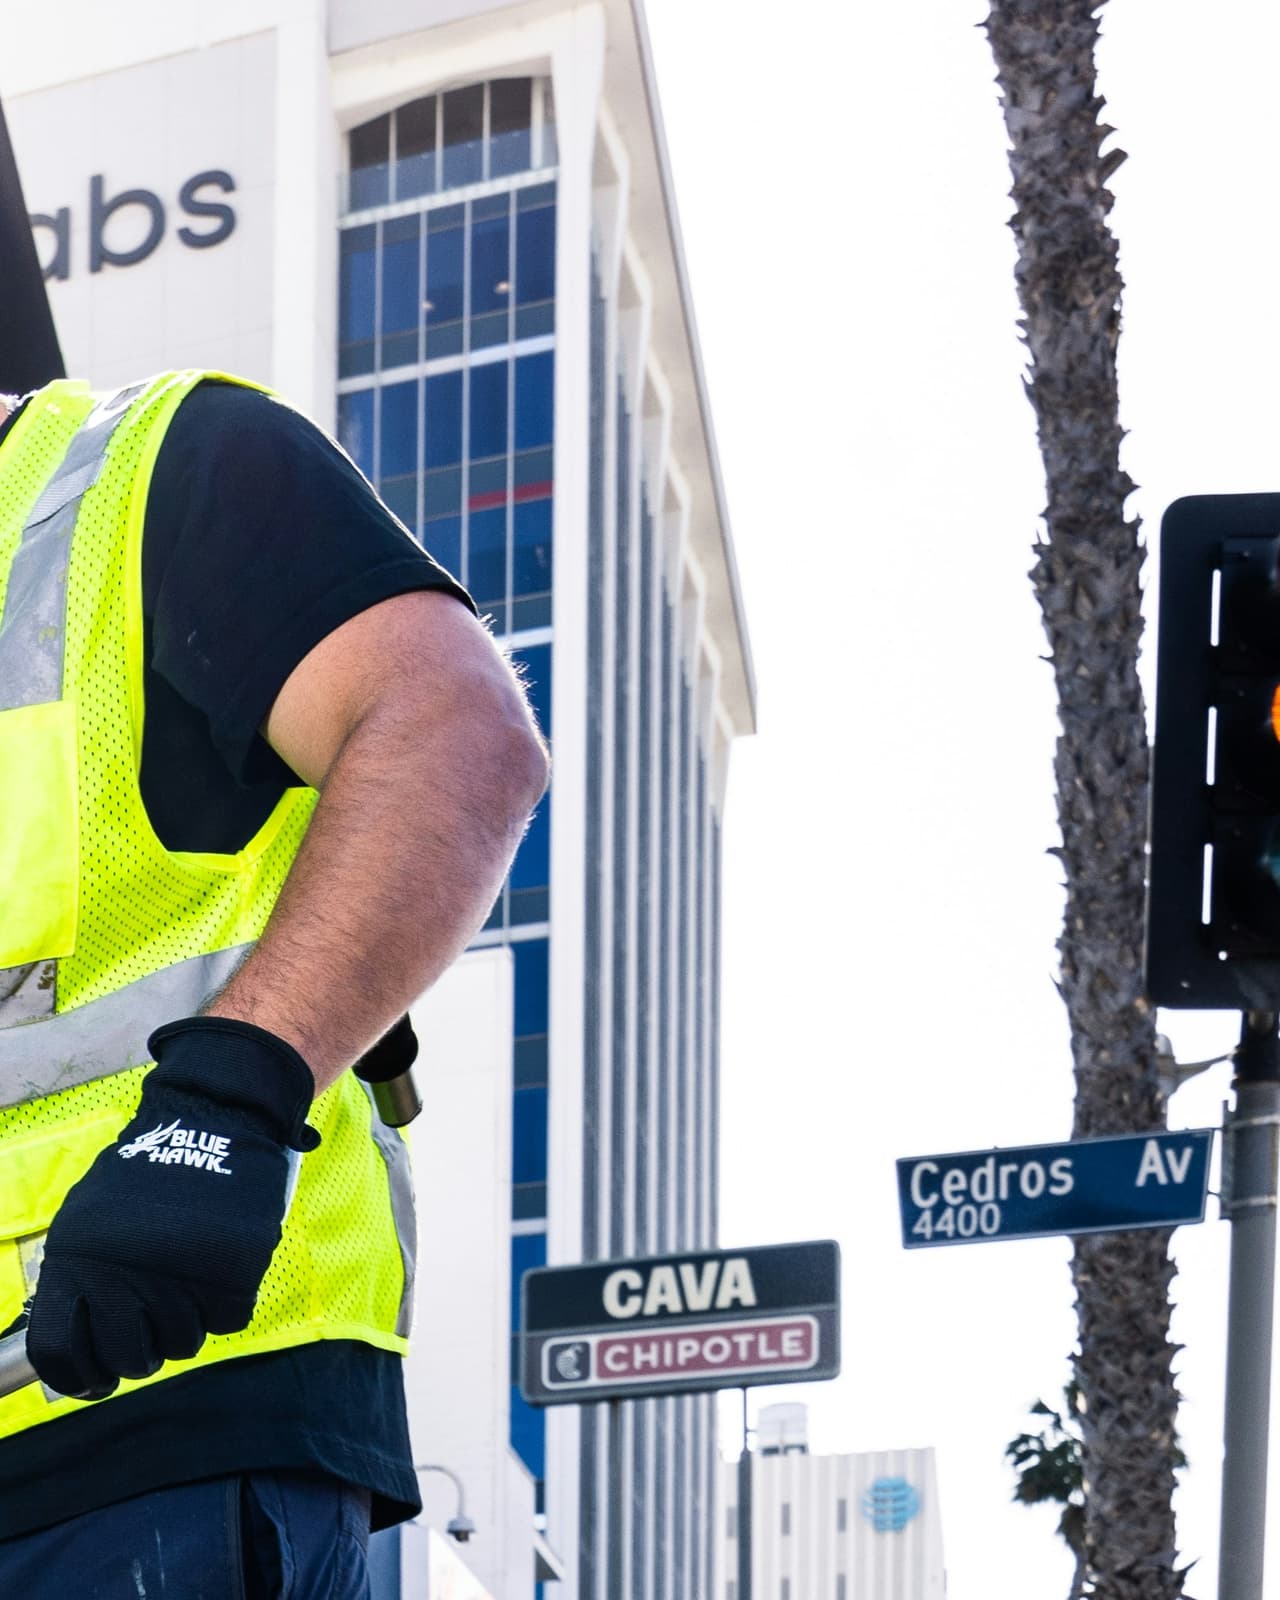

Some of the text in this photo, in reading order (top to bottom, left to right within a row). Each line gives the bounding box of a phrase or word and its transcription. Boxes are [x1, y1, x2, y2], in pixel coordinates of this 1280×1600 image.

[149, 1147, 225, 1174] HAWK
[169, 1129, 232, 1157] BLUE
[910, 1138, 1193, 1209] Cedros Av
[912, 1203, 1000, 1239] 4400
[602, 1258, 756, 1319] CAVA
[603, 1327, 806, 1375] CHIPOTLE
